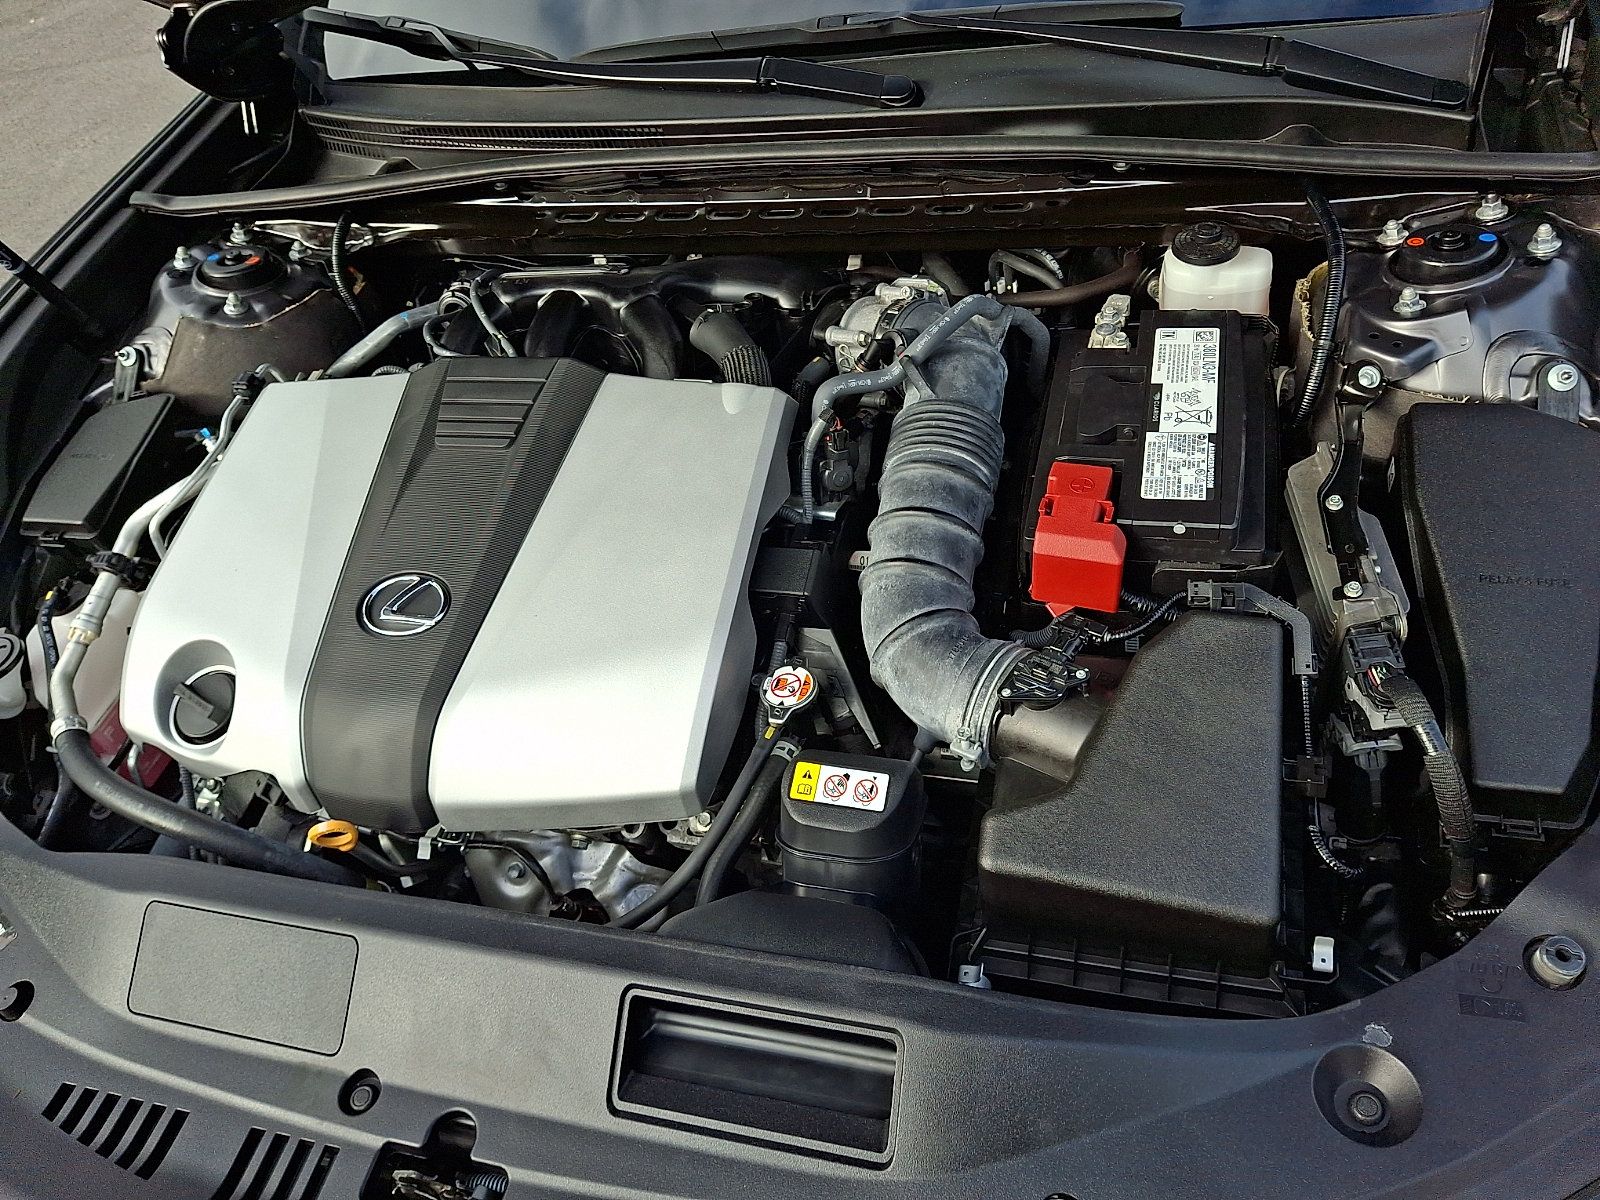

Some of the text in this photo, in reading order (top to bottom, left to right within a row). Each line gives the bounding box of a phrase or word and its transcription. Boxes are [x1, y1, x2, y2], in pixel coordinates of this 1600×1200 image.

[1202, 344, 1216, 384] 380LN3-MF
[1152, 401, 1160, 422] CLARIOS
[1163, 412, 1173, 422] Pb
